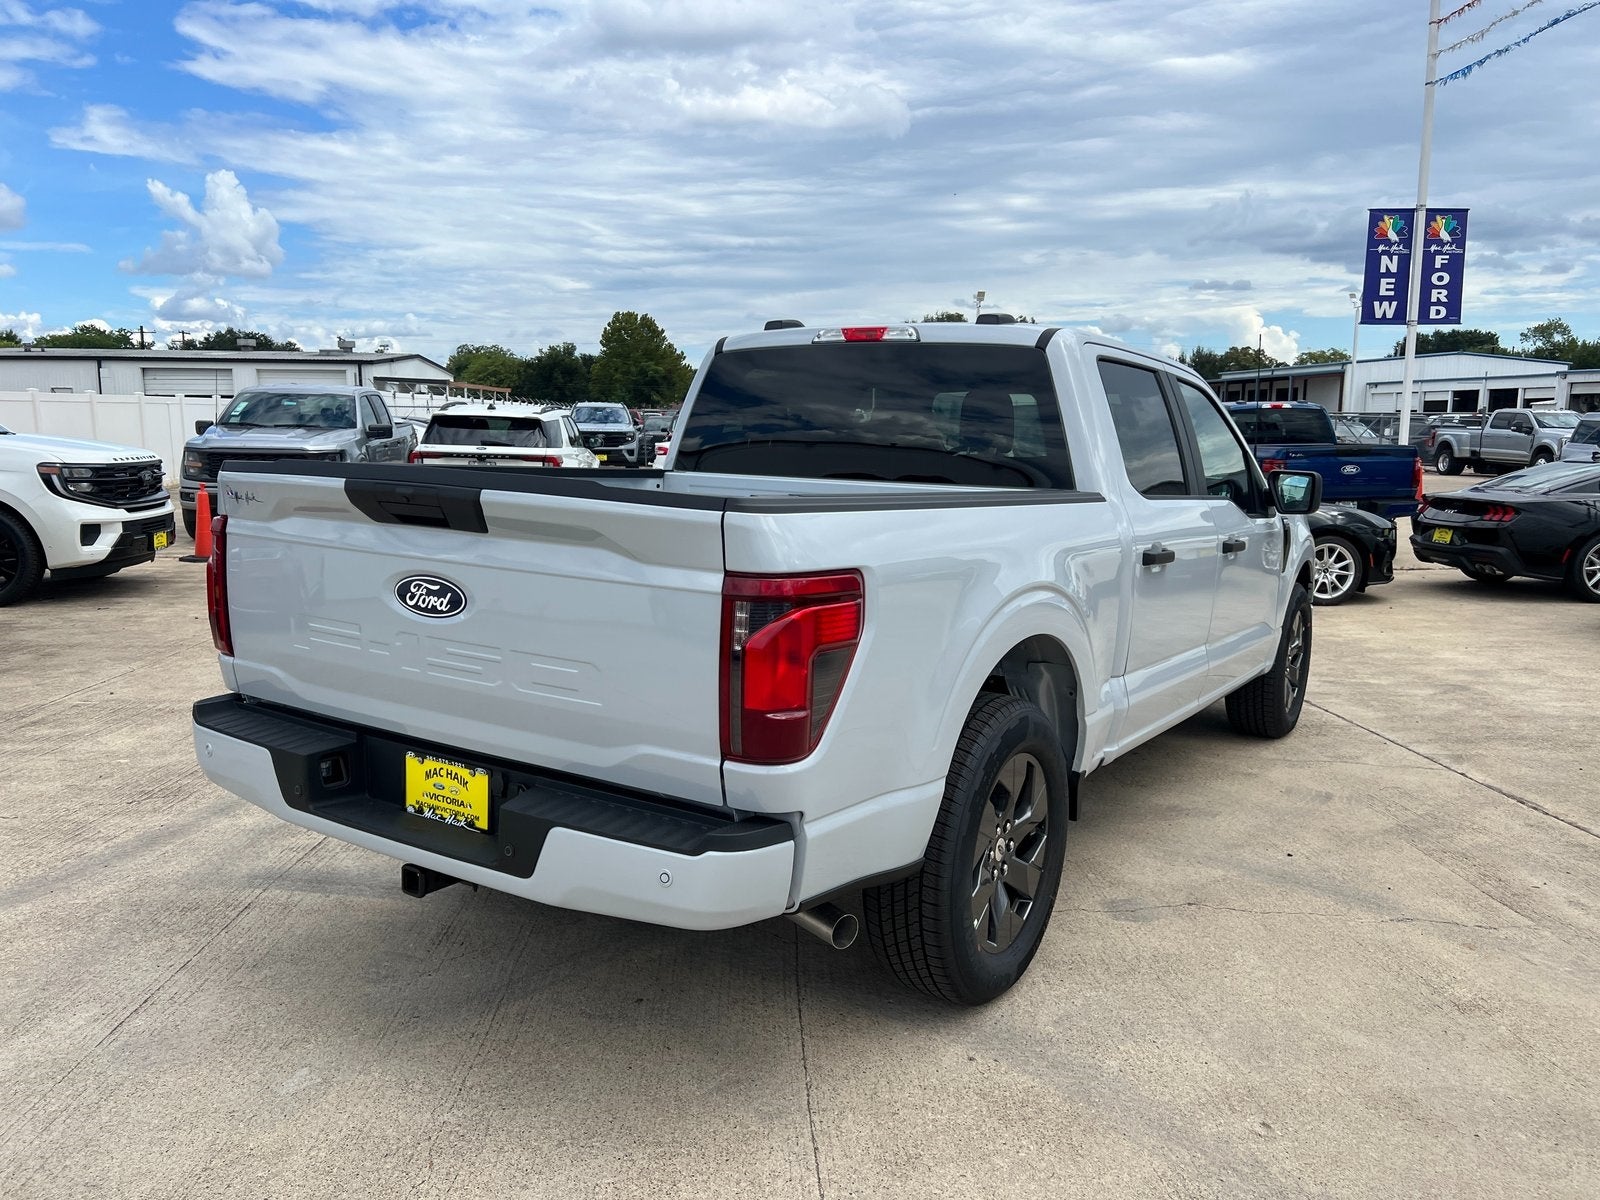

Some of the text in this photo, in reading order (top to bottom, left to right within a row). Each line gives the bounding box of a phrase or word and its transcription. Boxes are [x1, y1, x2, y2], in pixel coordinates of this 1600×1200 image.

[1373, 255, 1399, 319] NEW
[1429, 255, 1451, 319] FORD
[406, 581, 451, 611] Ford
[425, 767, 444, 781] MAC
[446, 768, 469, 792] HAIK
[428, 791, 466, 809] VICTORIA
[422, 807, 470, 829] Mac Haik
